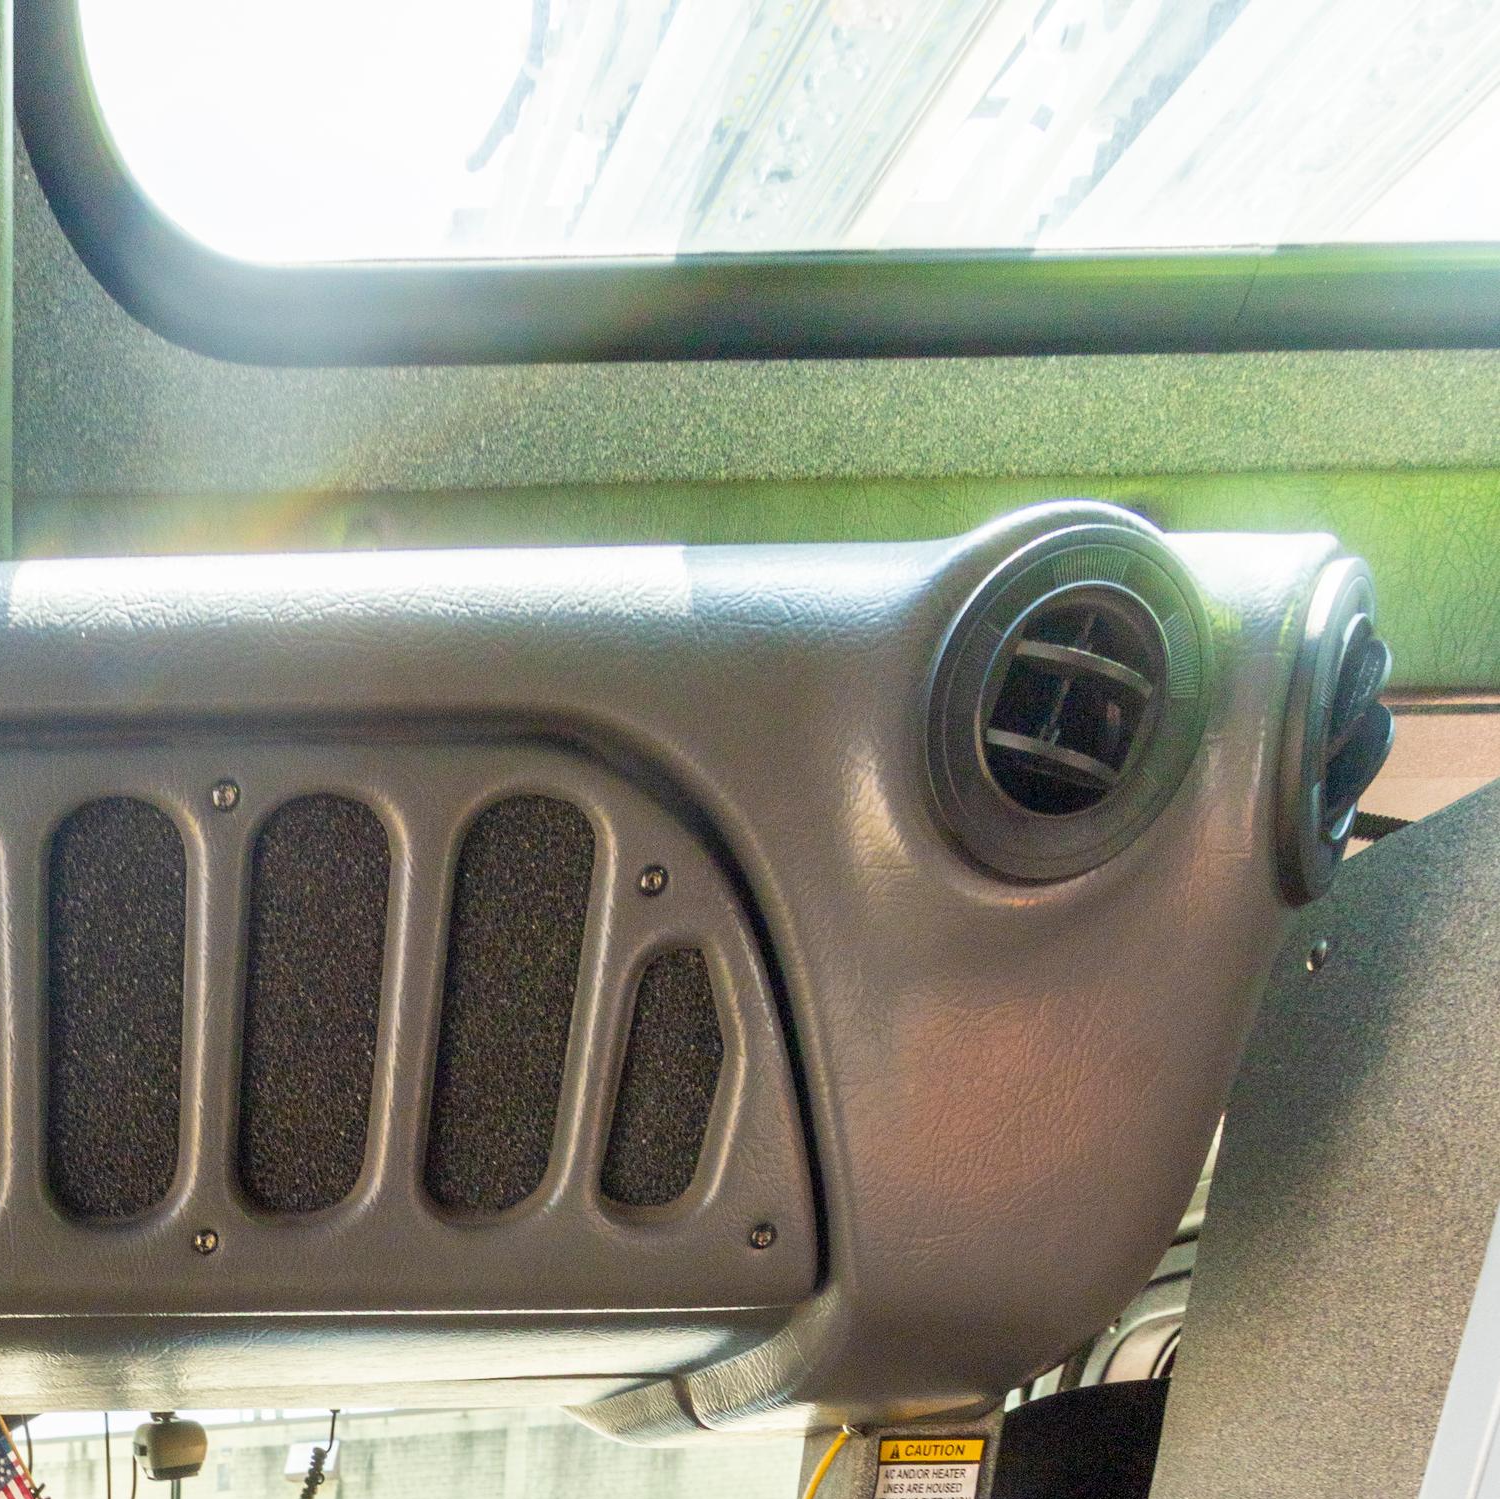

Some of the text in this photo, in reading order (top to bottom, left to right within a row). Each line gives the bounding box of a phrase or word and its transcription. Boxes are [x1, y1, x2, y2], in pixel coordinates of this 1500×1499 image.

[904, 1444, 965, 1456] CAUTION
[897, 1469, 930, 1479] AND/OR
[932, 1468, 966, 1478] HEATER
[883, 1483, 962, 1493] LINES ARE HOUSED
